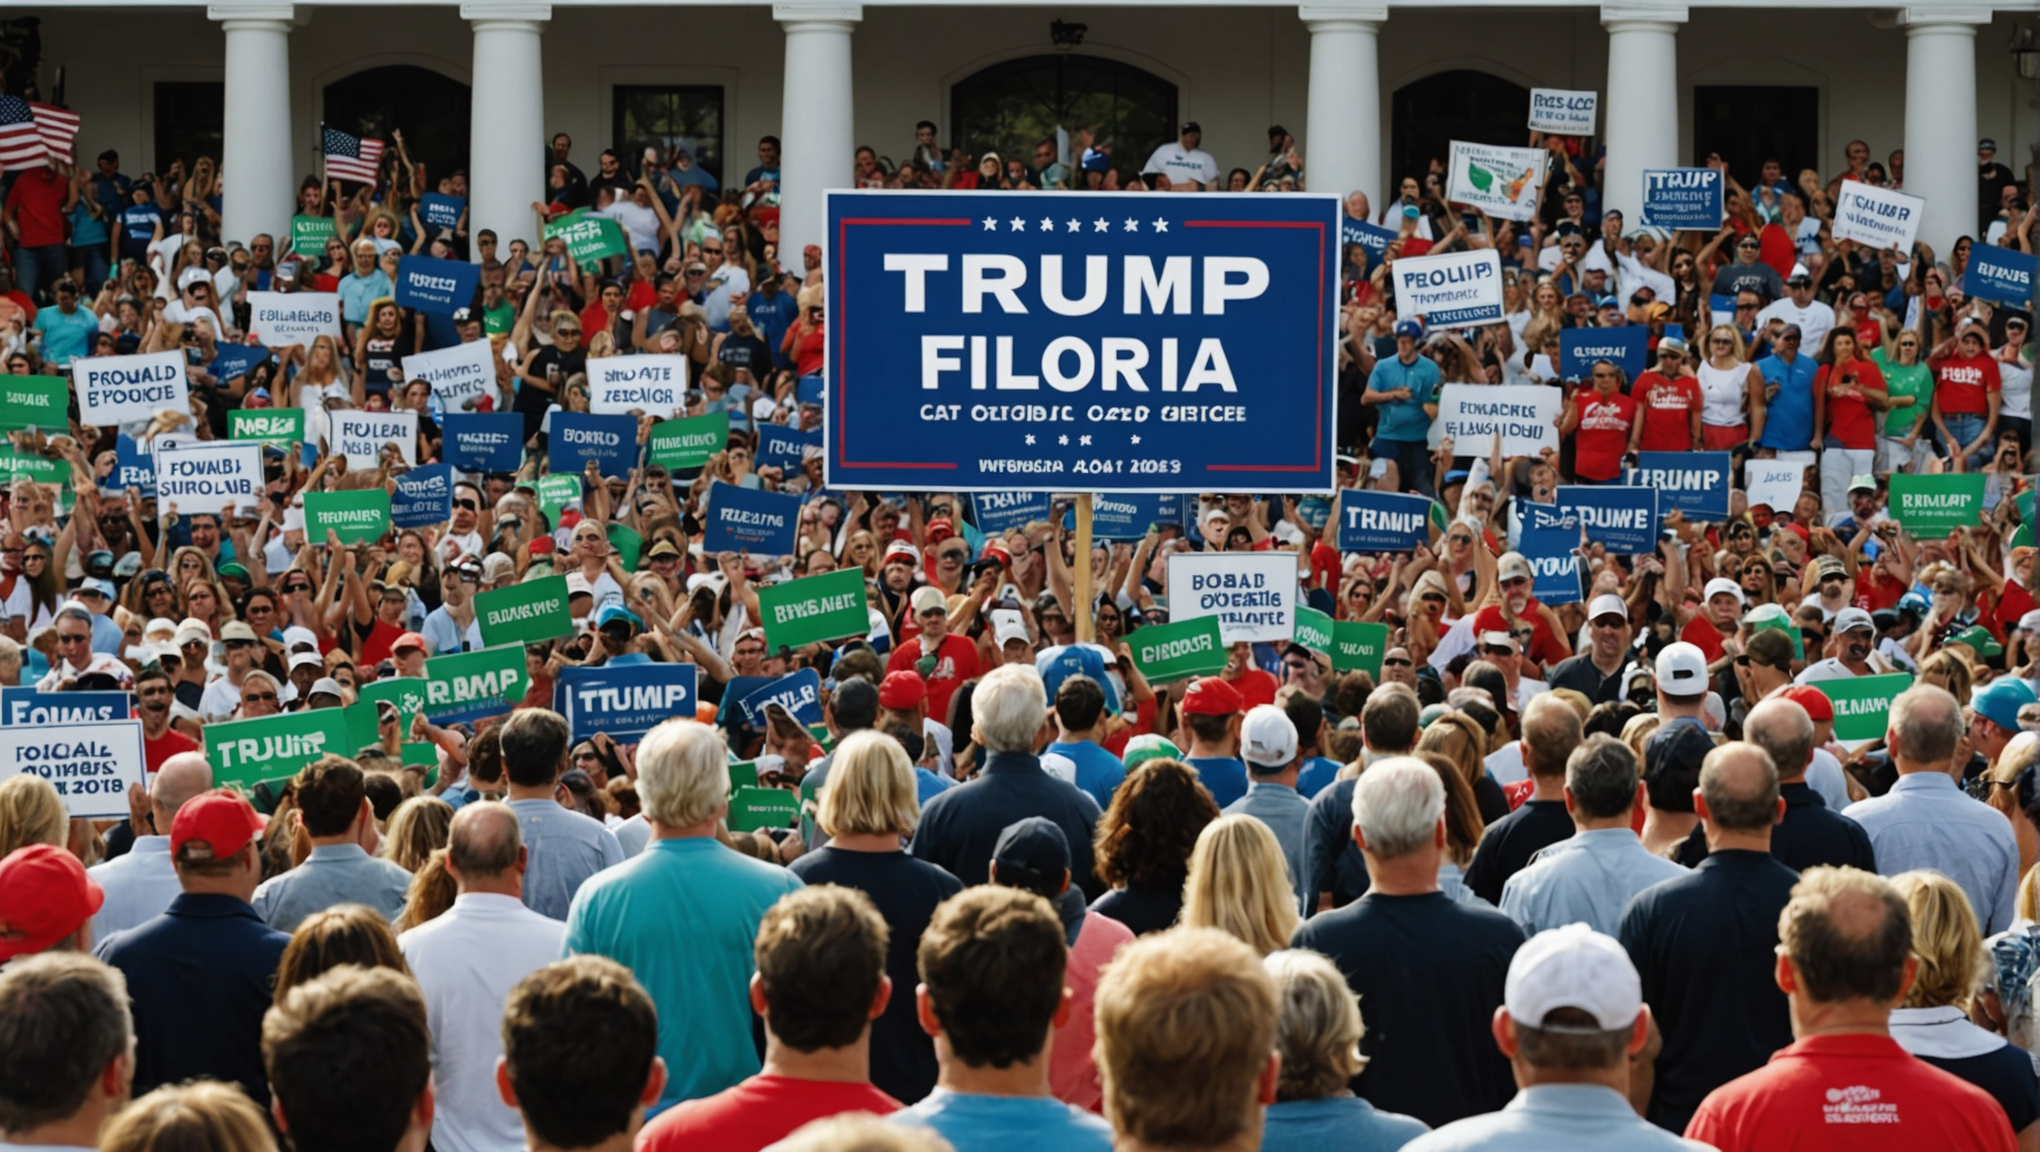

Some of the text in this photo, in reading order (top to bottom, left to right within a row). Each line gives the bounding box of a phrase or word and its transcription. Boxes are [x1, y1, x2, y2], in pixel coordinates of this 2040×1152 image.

[883, 253, 1270, 317] TRUMP
[921, 335, 1238, 393] FILORIA
[920, 404, 961, 421] CAT
